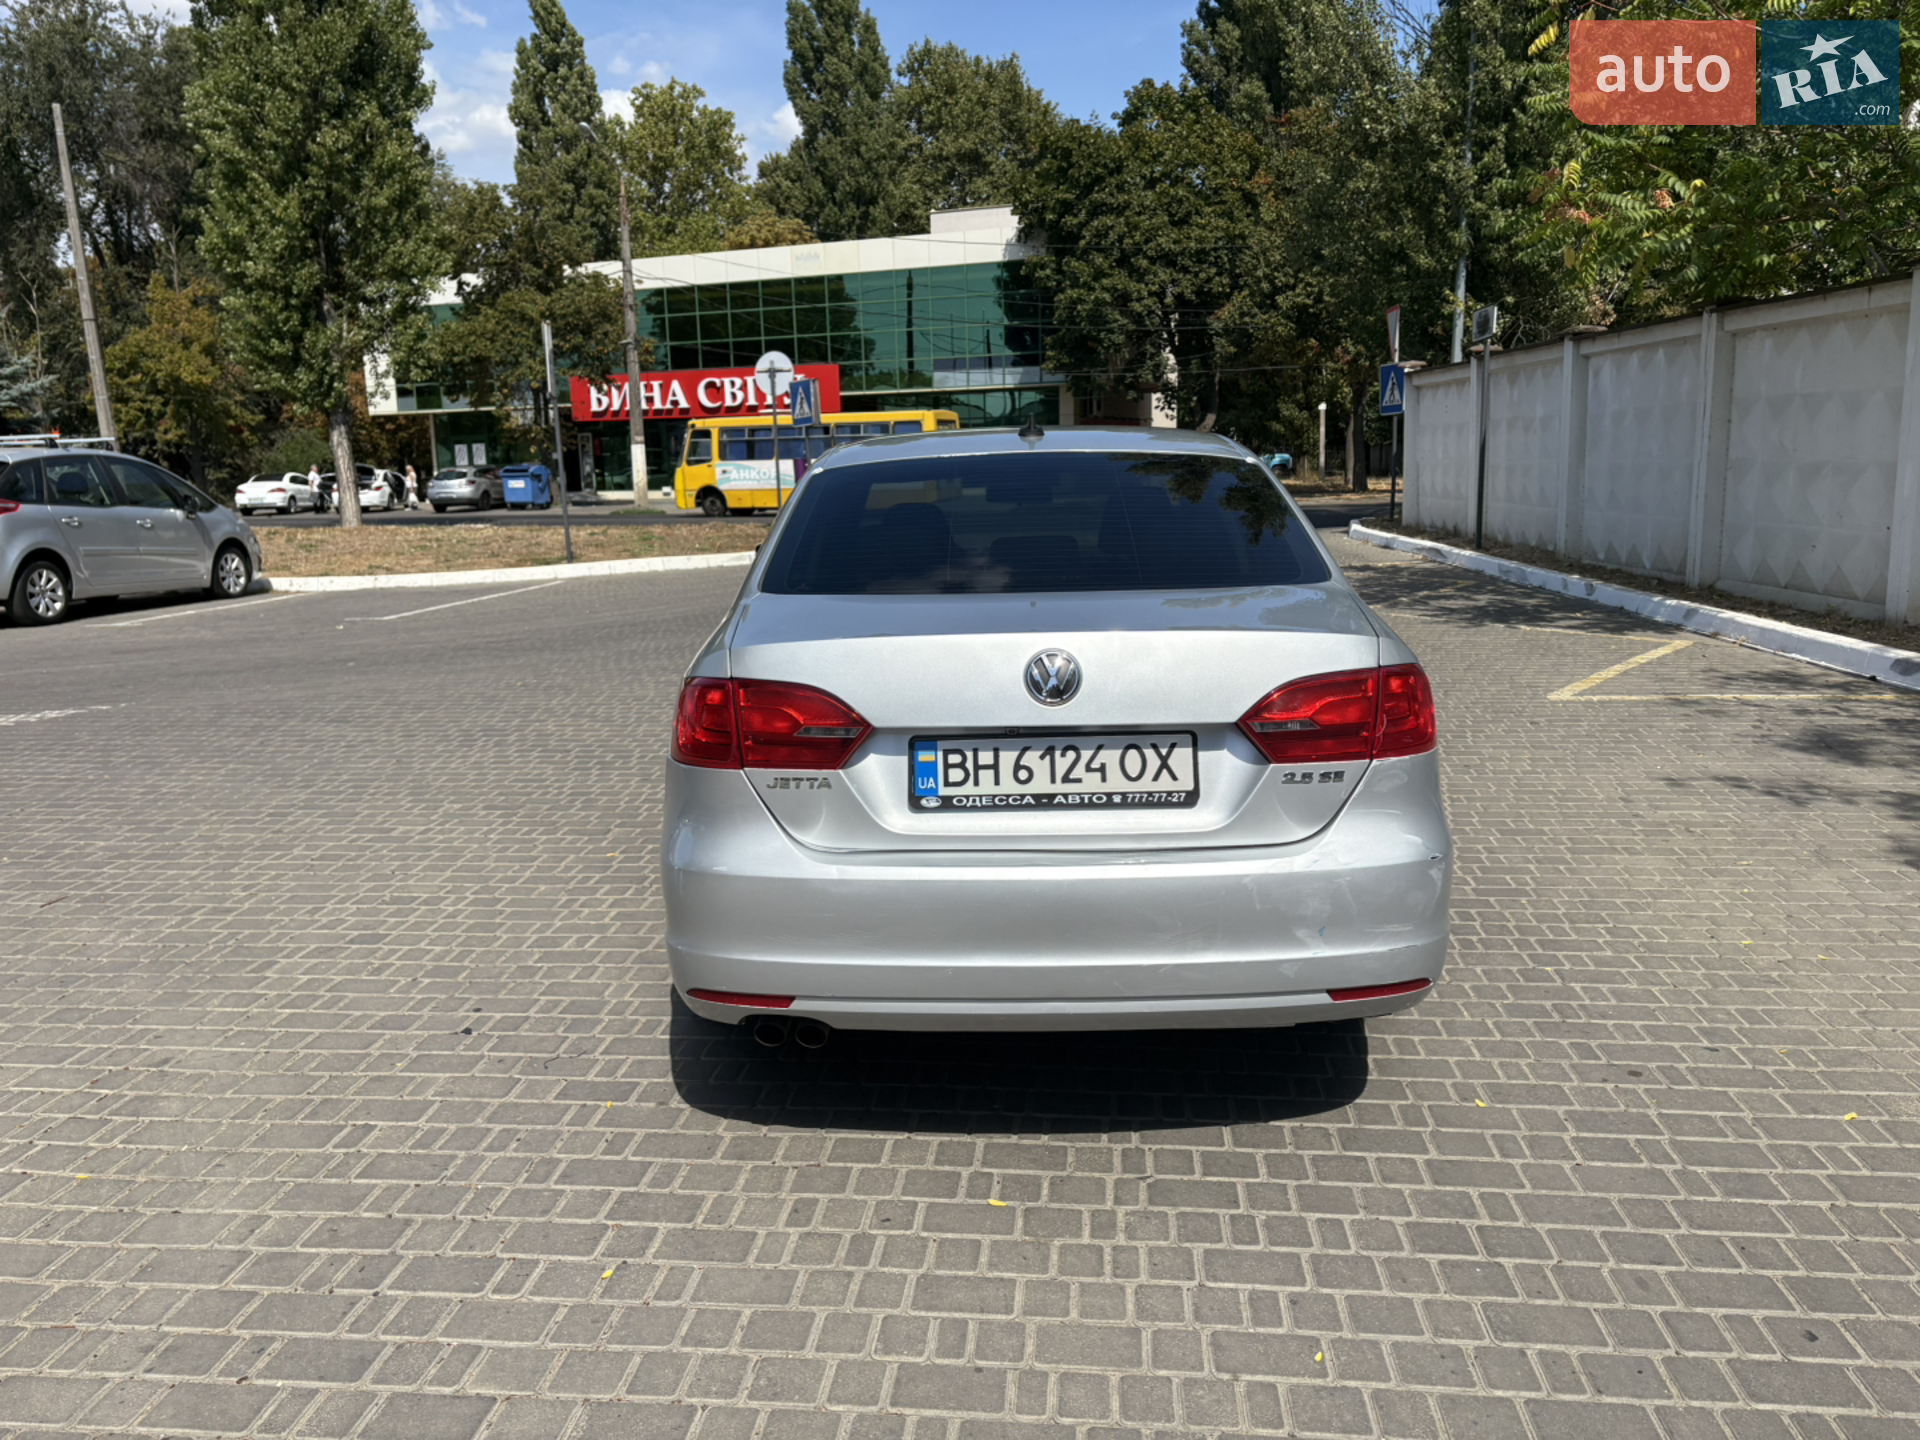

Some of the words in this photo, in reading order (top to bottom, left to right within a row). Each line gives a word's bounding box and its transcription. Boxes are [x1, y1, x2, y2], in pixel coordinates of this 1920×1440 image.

[587, 379, 691, 412] ВИНА
[942, 747, 1001, 788] BH
[1012, 744, 1107, 786] 6124
[1119, 742, 1179, 782] OX
[766, 776, 832, 790] JETTA
[918, 777, 936, 789] UA
[1318, 769, 1346, 784] SE
[952, 795, 1036, 807] ОДЕССА
[1053, 793, 1108, 805] АВТО
[1125, 792, 1187, 803] 777-77-27
